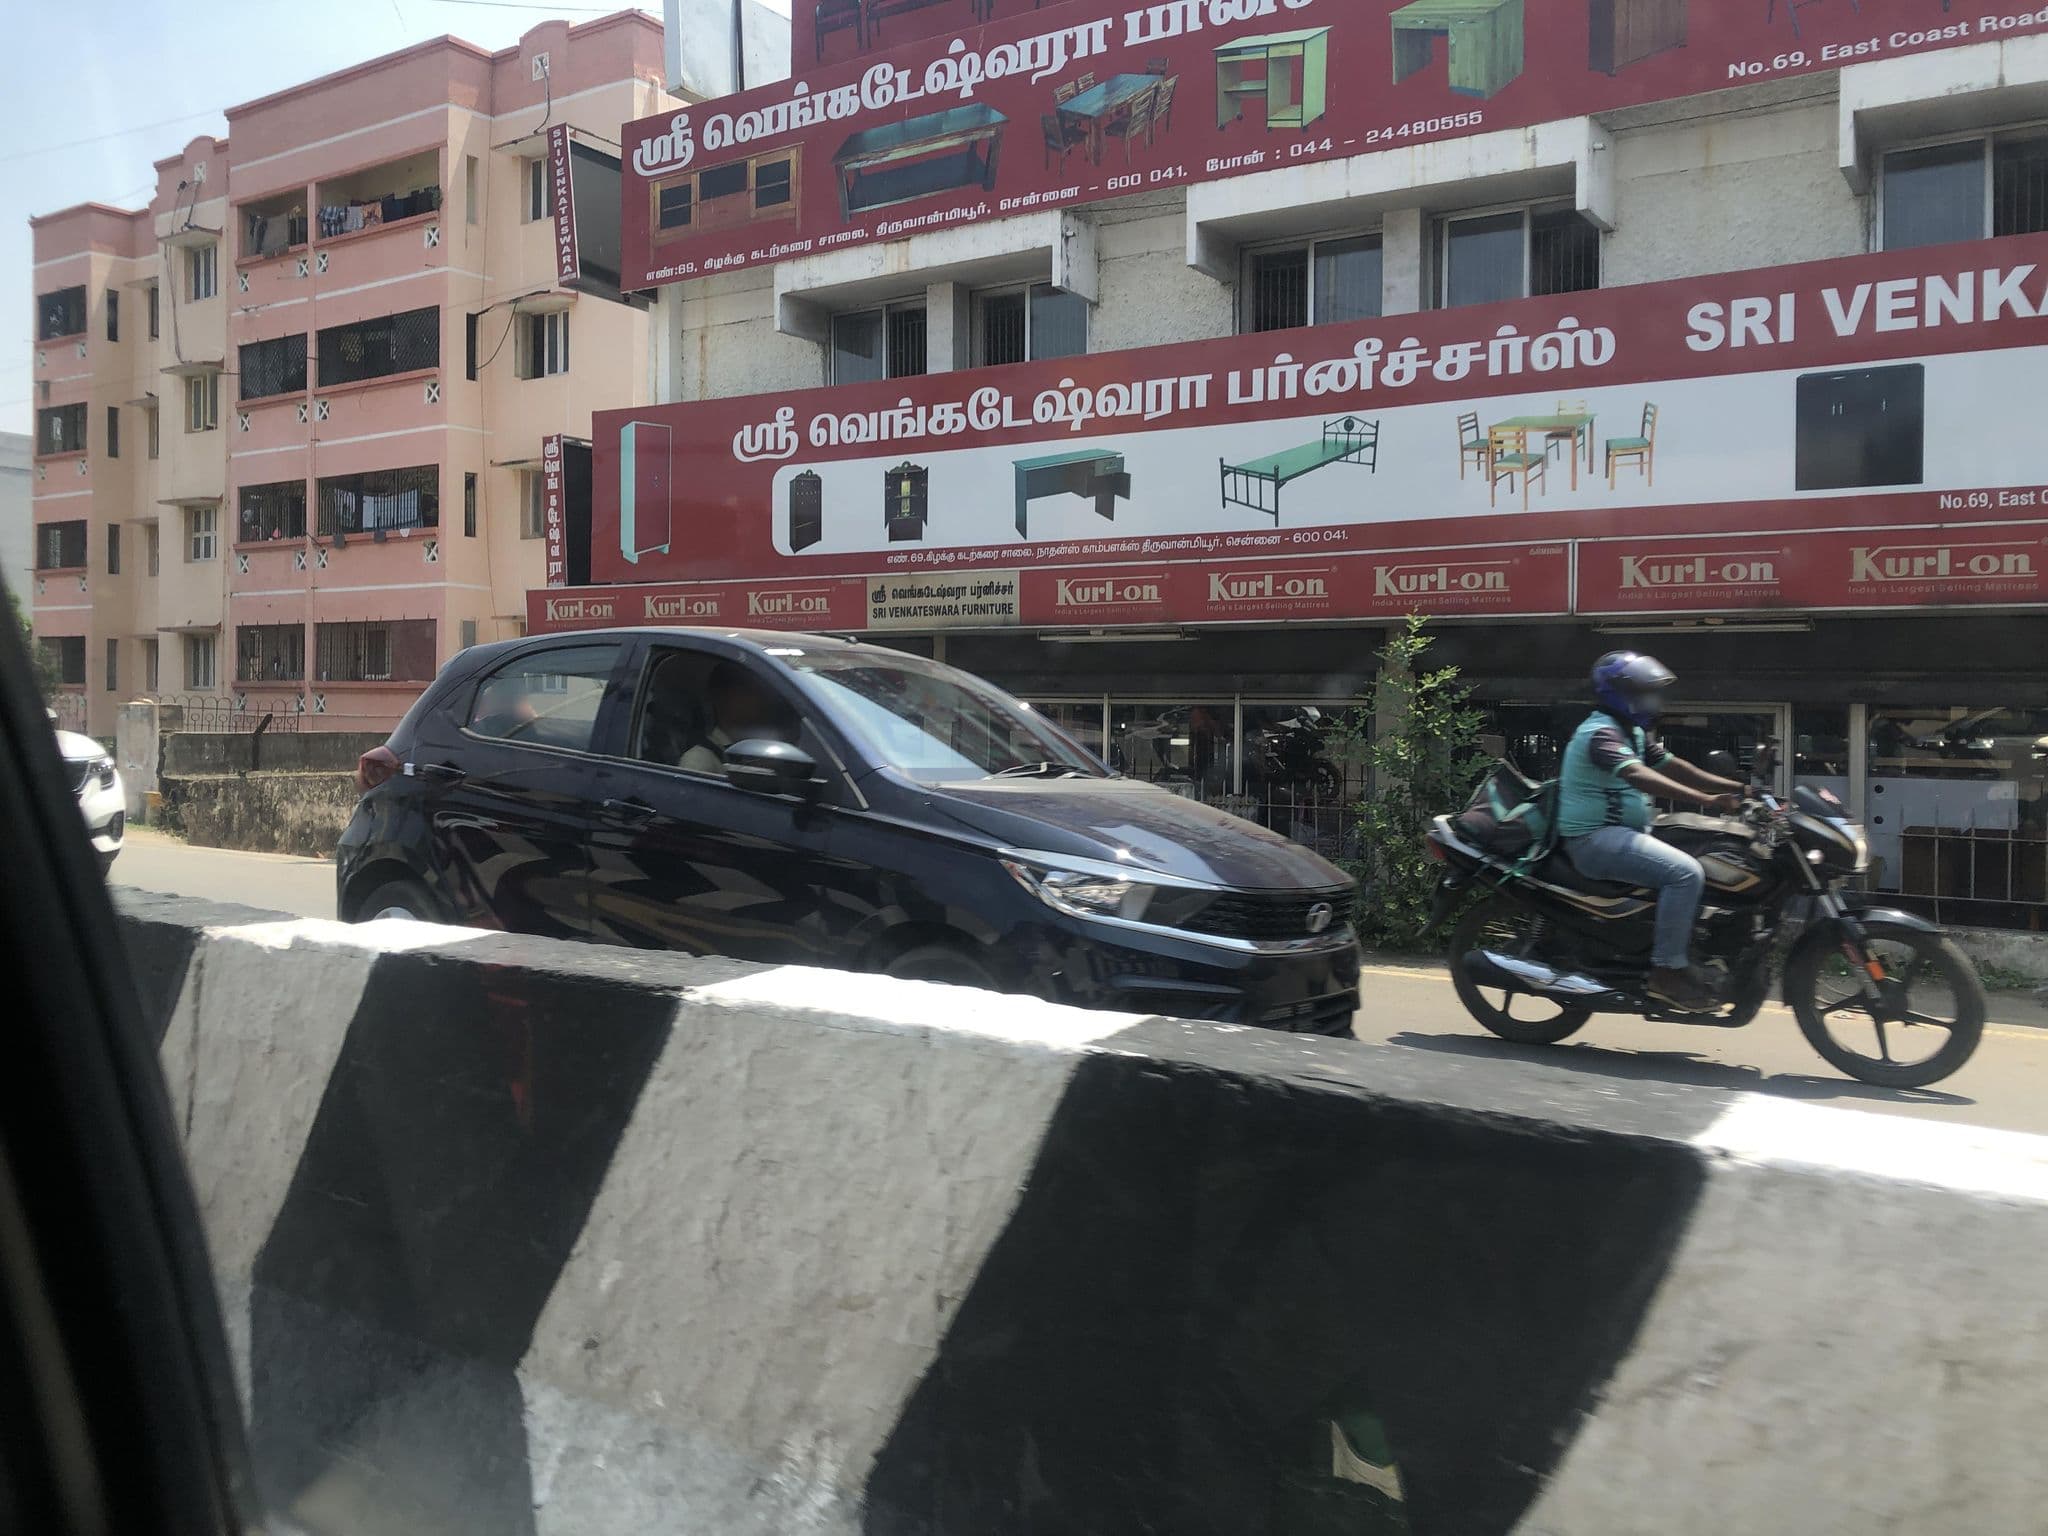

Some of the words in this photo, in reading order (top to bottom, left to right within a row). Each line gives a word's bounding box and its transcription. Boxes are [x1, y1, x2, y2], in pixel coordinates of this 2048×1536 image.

[1728, 51, 1813, 78] No.69,
[1821, 37, 1880, 61] East
[1889, 21, 1970, 48] Coast
[1979, 6, 2048, 33] Road
[1106, 173, 1142, 191] 600
[1149, 164, 1188, 183] 041.
[1289, 137, 1333, 158] 044
[1365, 110, 1483, 144] 24480555
[1685, 291, 1796, 353] SRI
[1820, 264, 2048, 338] VENK
[1940, 492, 1994, 510] No.69,
[1999, 490, 2036, 507] East
[1292, 531, 1321, 544] 600
[1323, 529, 1349, 542] 041.
[1619, 555, 1780, 589] Kurl-on
[1849, 546, 2038, 583] Kurl-on
[1056, 578, 1163, 606] Kurl-on
[1207, 572, 1329, 602] Kurl-on
[1373, 565, 1510, 597] Kurl-on
[545, 598, 616, 621] Kurl-on
[643, 594, 721, 619] Kurl-on
[746, 591, 831, 616] Kurl-on
[872, 607, 887, 619] SRI
[889, 604, 960, 618] VENKATESWARA
[962, 602, 1014, 616] FURNITURE
